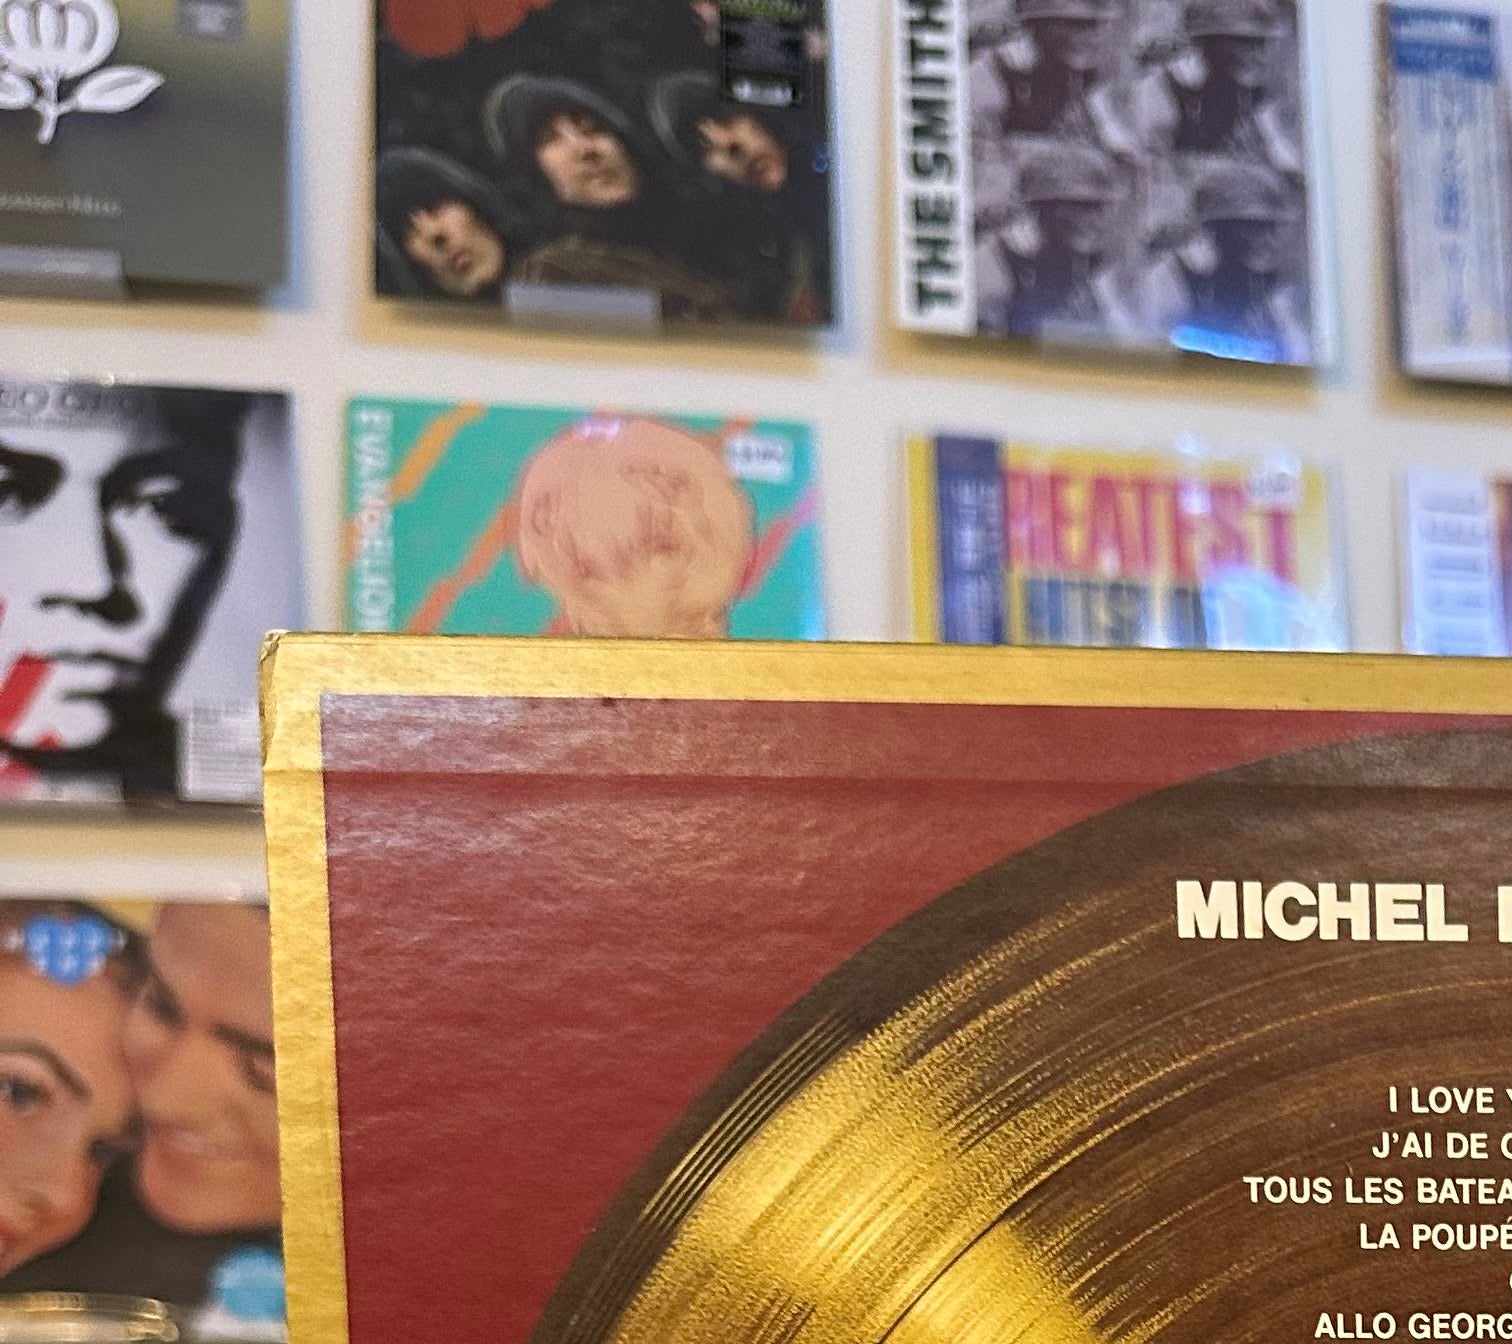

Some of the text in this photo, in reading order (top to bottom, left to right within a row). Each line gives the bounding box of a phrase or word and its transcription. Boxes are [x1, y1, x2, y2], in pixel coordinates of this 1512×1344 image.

[912, 190, 961, 315] THE
[1175, 879, 1469, 942] MICHEL
[1389, 1085, 1398, 1113] I
[1411, 1085, 1495, 1114] LOVE
[1371, 1131, 1433, 1159] J'AI
[1446, 1132, 1489, 1160] DE
[1242, 1175, 1333, 1205] TOUS
[1345, 1177, 1404, 1205] LES
[1359, 1222, 1401, 1250] LA
[1314, 1312, 1397, 1340] ALLO
